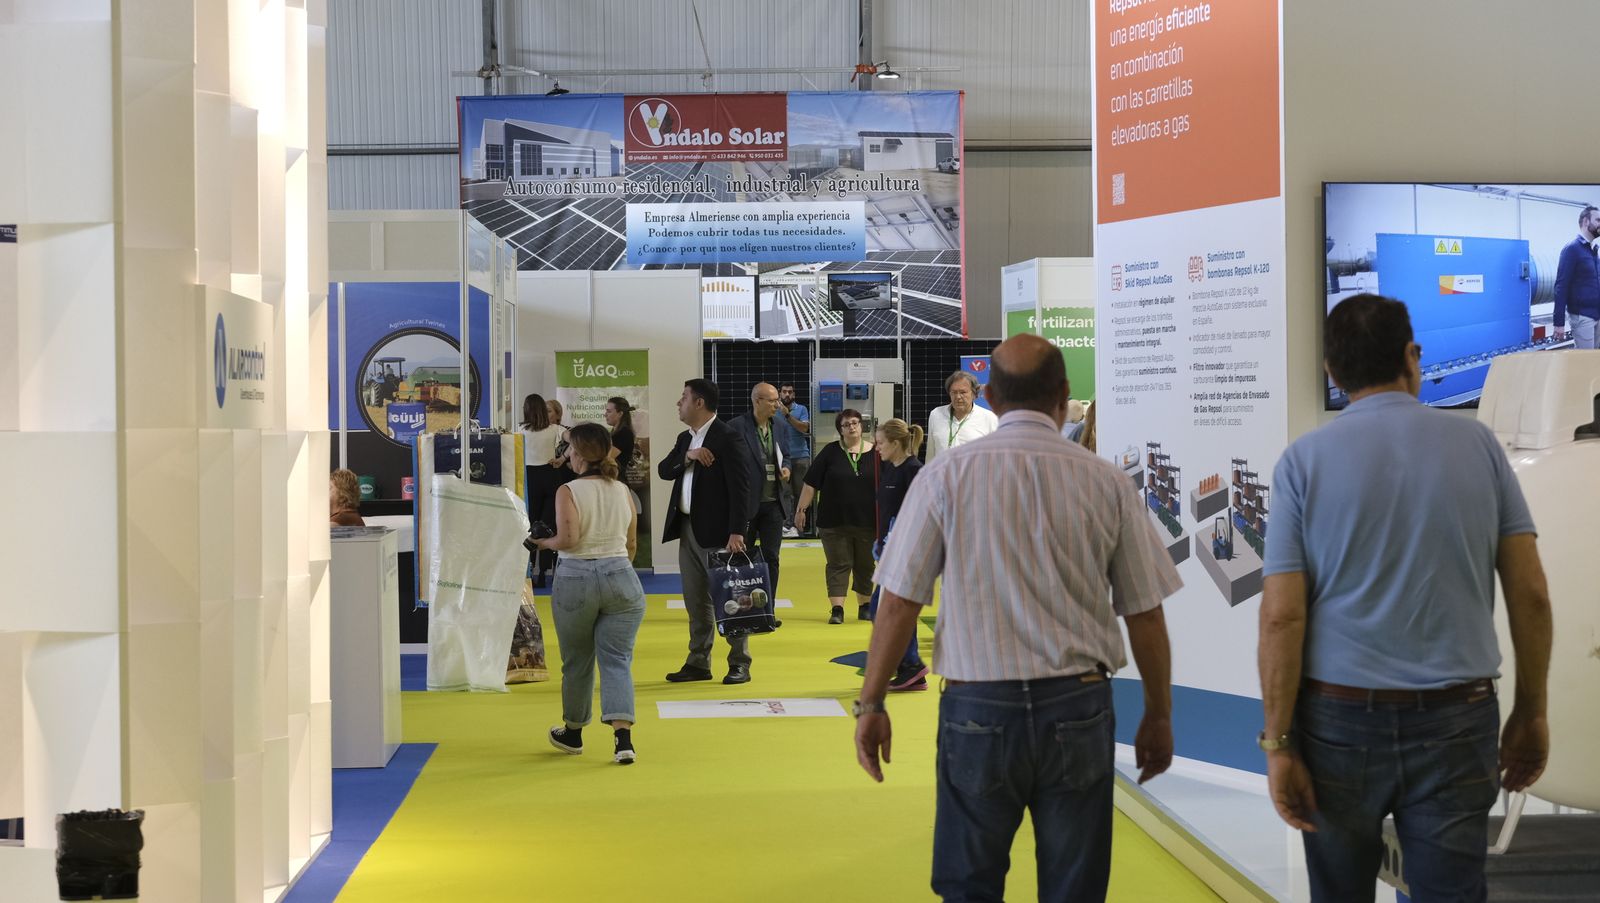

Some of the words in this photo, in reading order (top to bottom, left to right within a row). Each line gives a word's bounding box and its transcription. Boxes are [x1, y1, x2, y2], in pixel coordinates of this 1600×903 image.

[1110, 27, 1127, 47] una
[1129, 12, 1164, 41] energía
[1166, 2, 1211, 32] eficiente
[1110, 62, 1122, 80] en
[1124, 42, 1184, 77] combinación
[1111, 94, 1127, 113] con
[1129, 88, 1143, 109] las
[1145, 76, 1193, 105] carretillas
[639, 103, 723, 146] Yndalo
[728, 127, 785, 145] Solar
[1111, 120, 1161, 146] elevadoras
[1163, 118, 1169, 135] a
[1172, 113, 1190, 139] gas
[503, 176, 617, 196] Autoconsumo
[622, 174, 716, 197] residencial,
[726, 173, 808, 193] industrial
[812, 179, 823, 198] y
[828, 172, 921, 198] agricultura
[644, 211, 685, 226] Empresa
[688, 211, 740, 222] Almeriense
[743, 213, 759, 222] con
[762, 210, 794, 225] amplia
[797, 210, 850, 224] experiencia
[648, 228, 694, 237] Podemos
[697, 227, 729, 237] cubrir
[732, 227, 759, 236] todas
[763, 227, 779, 236] tus
[782, 226, 846, 236] necesidades.
[638, 243, 677, 256] ¿Conoce
[680, 244, 697, 255] por
[700, 244, 717, 255] que
[720, 244, 737, 252] nos
[771, 243, 811, 252] nuestros
[814, 241, 857, 252] clientes?
[1207, 251, 1234, 262] Suministro
[1235, 250, 1245, 259] con
[1125, 262, 1149, 272] Suministro
[1150, 261, 1159, 269] con
[1207, 268, 1233, 279] bombonas
[1234, 264, 1252, 277] Repsol
[1253, 263, 1270, 275] K-120
[1125, 277, 1135, 288] Skid
[1136, 276, 1152, 288] Repsol
[1153, 274, 1173, 285] AutoGas
[389, 319, 423, 329] Agricultural
[425, 319, 446, 329] Twines
[1028, 316, 1096, 328] frtilizan
[585, 364, 618, 379] AGQ
[618, 369, 636, 377] Labs
[1193, 391, 1208, 401] Amplia
[1216, 391, 1222, 400] de
[1222, 390, 1241, 402] Agencias
[1242, 391, 1248, 399] de
[1248, 390, 1270, 399] Envasado
[1193, 404, 1199, 413] de
[1199, 404, 1207, 413] Gas
[1208, 404, 1222, 414] Repsol
